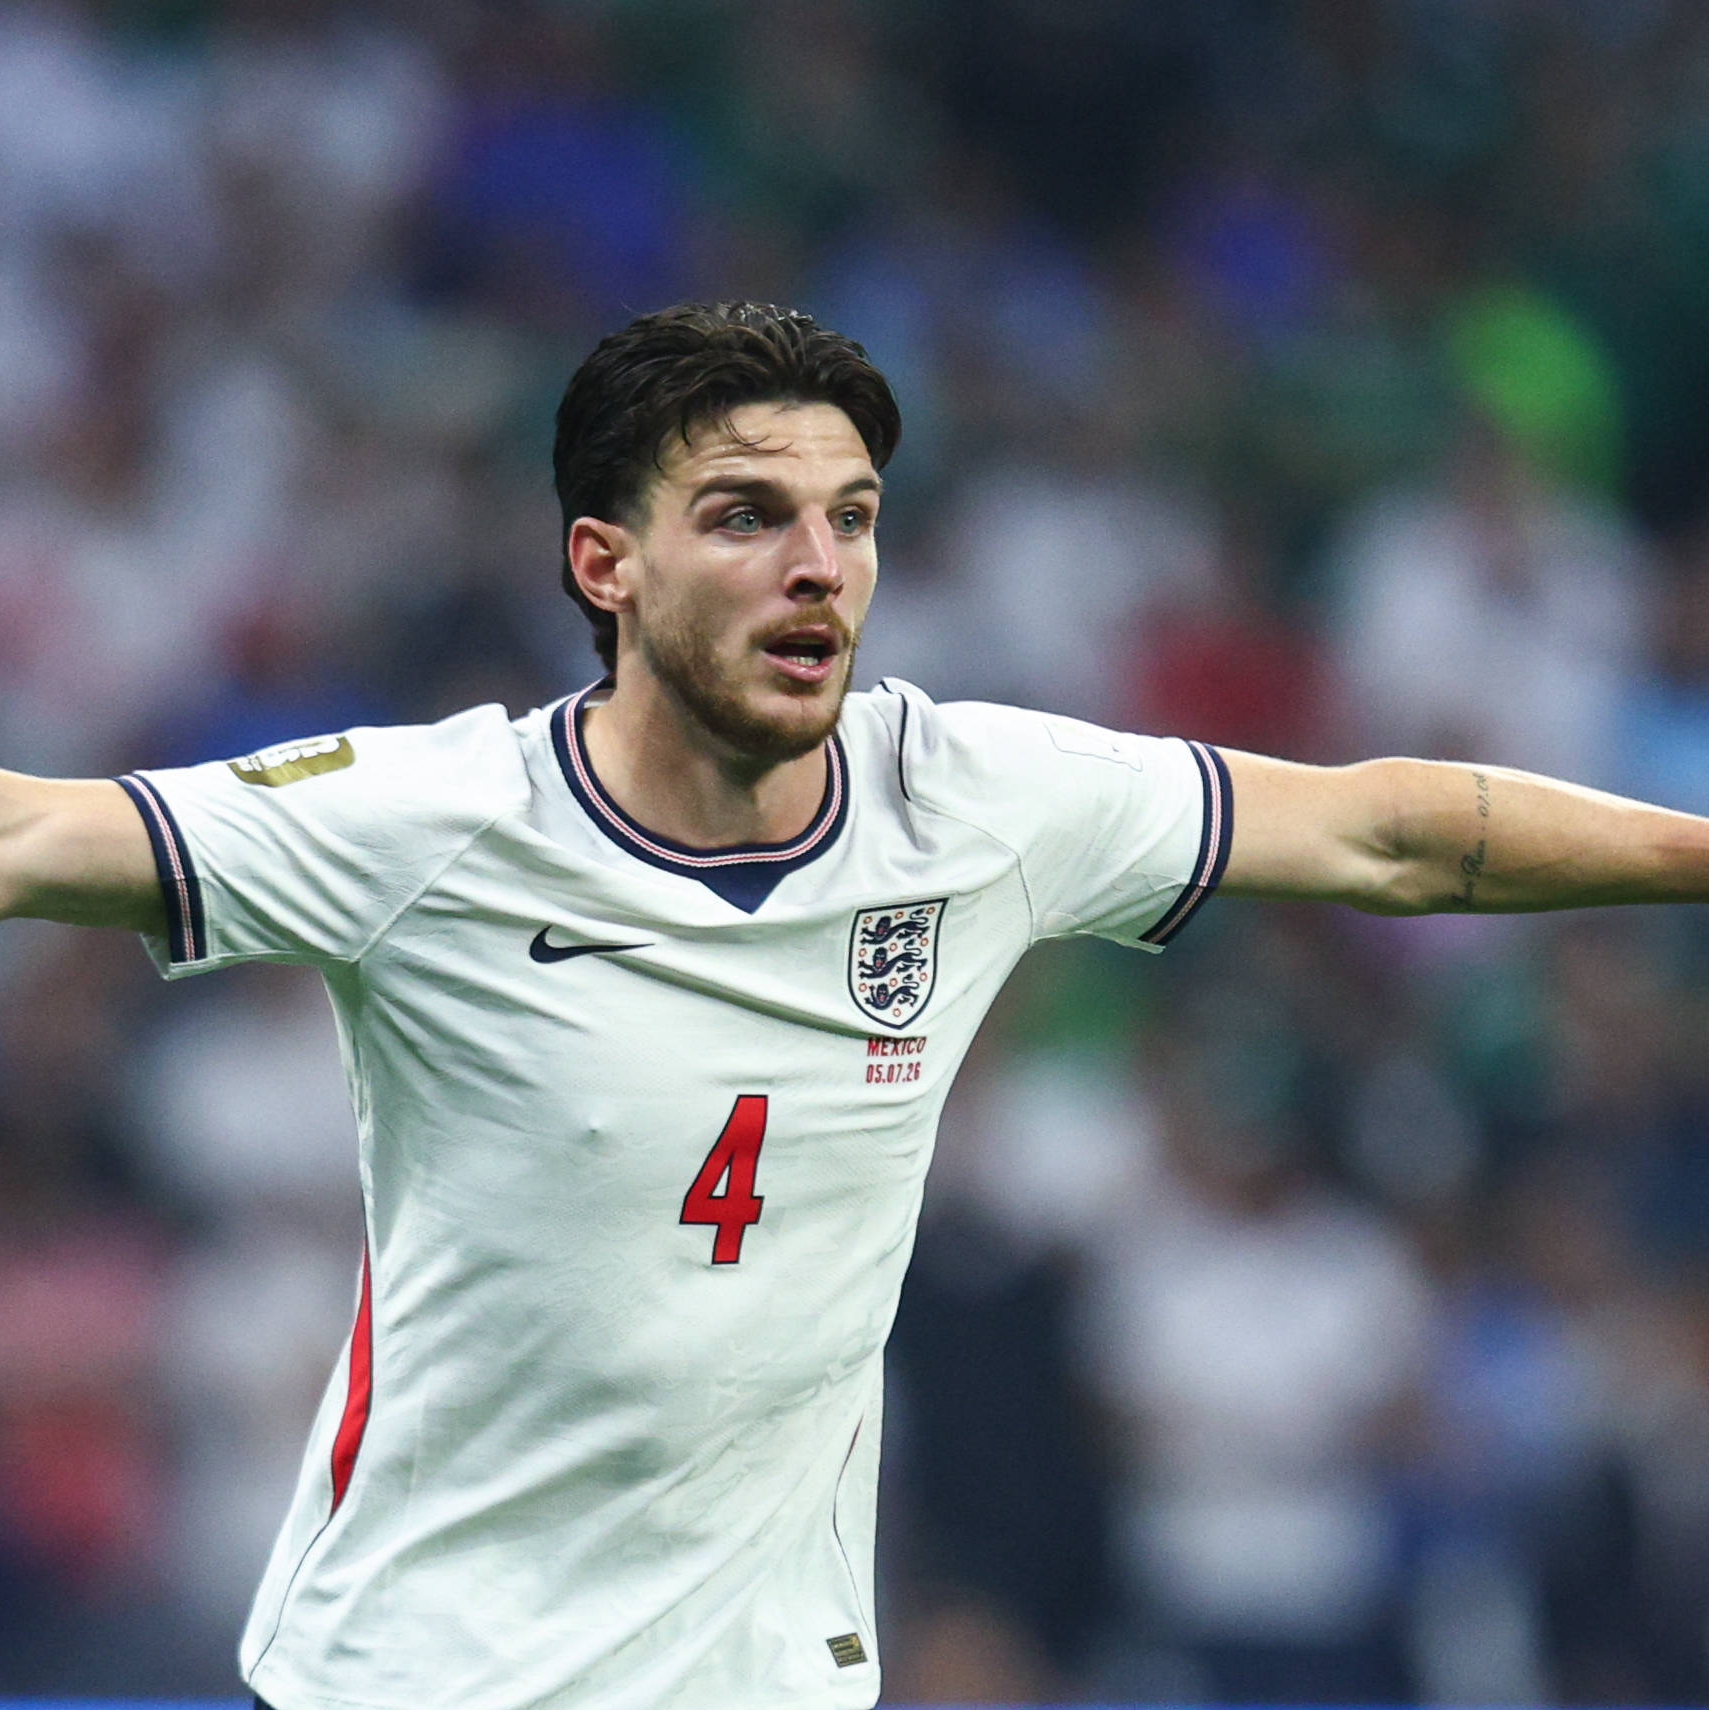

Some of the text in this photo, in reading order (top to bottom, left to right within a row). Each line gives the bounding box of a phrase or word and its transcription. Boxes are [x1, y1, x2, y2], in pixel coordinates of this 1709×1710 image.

[867, 1036, 927, 1057] MEXICO
[865, 1061, 921, 1084] 05.07.26
[679, 1094, 769, 1265] 4
